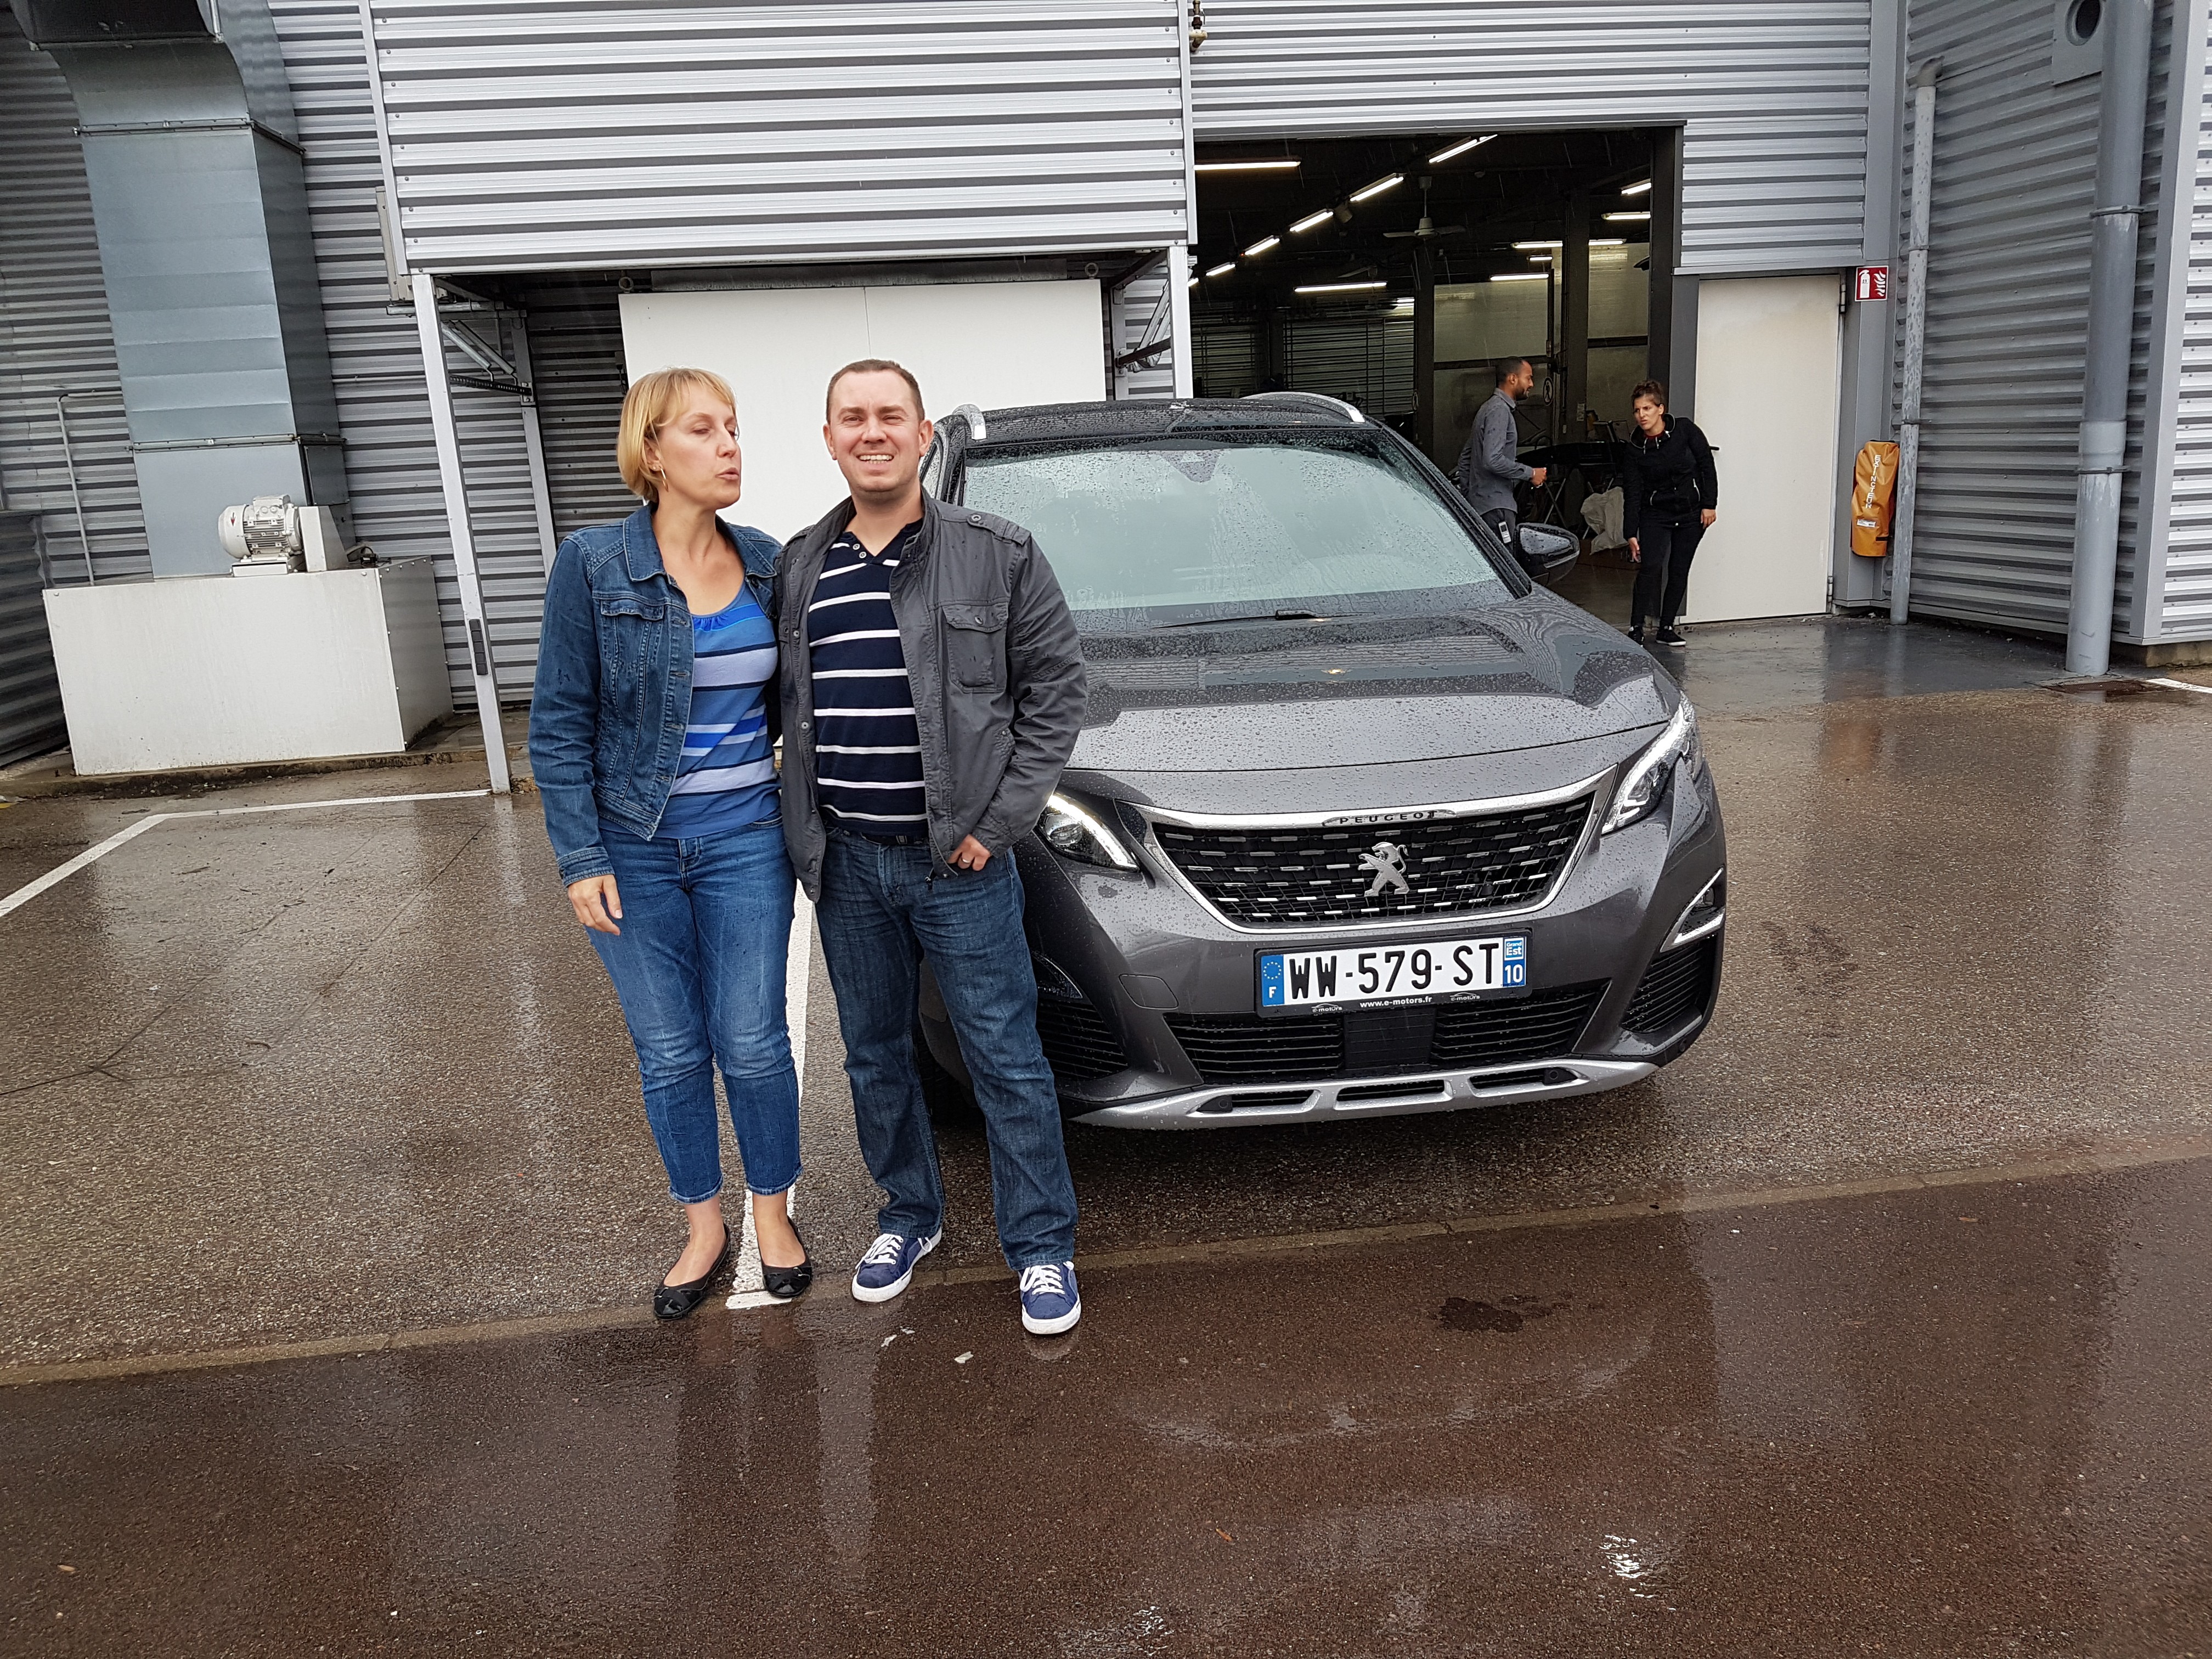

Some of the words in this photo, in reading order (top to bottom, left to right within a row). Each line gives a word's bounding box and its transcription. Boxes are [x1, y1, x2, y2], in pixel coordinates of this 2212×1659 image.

[1865, 455, 1881, 509] EXTINCTEUR
[1340, 810, 1438, 825] PEUGEOT
[1506, 946, 1522, 956] Est
[1504, 964, 1523, 984] 10
[1268, 986, 1277, 998] F
[1359, 995, 1432, 1008] www.e-motors.fr
